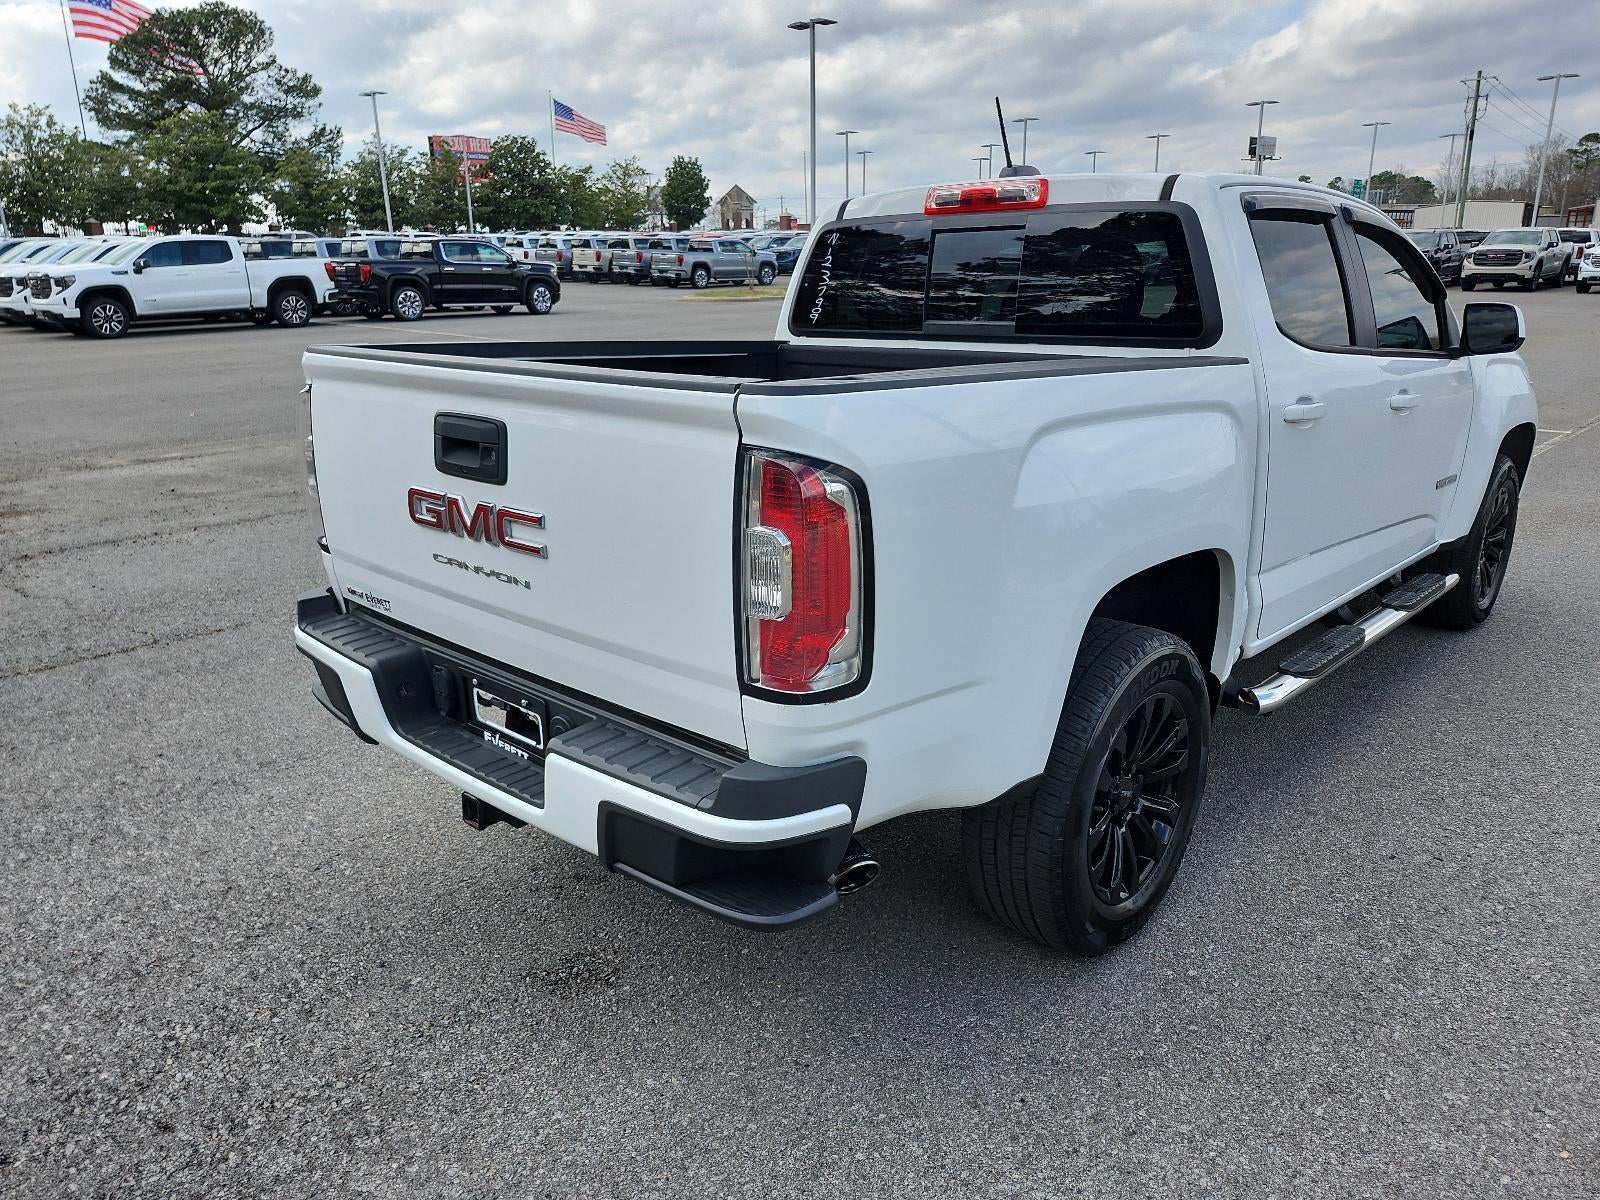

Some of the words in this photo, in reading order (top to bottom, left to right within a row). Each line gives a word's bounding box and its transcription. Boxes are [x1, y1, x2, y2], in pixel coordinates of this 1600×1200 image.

[407, 485, 548, 559] GMC
[433, 553, 532, 590] CANYON
[484, 731, 529, 760] EVERETT
